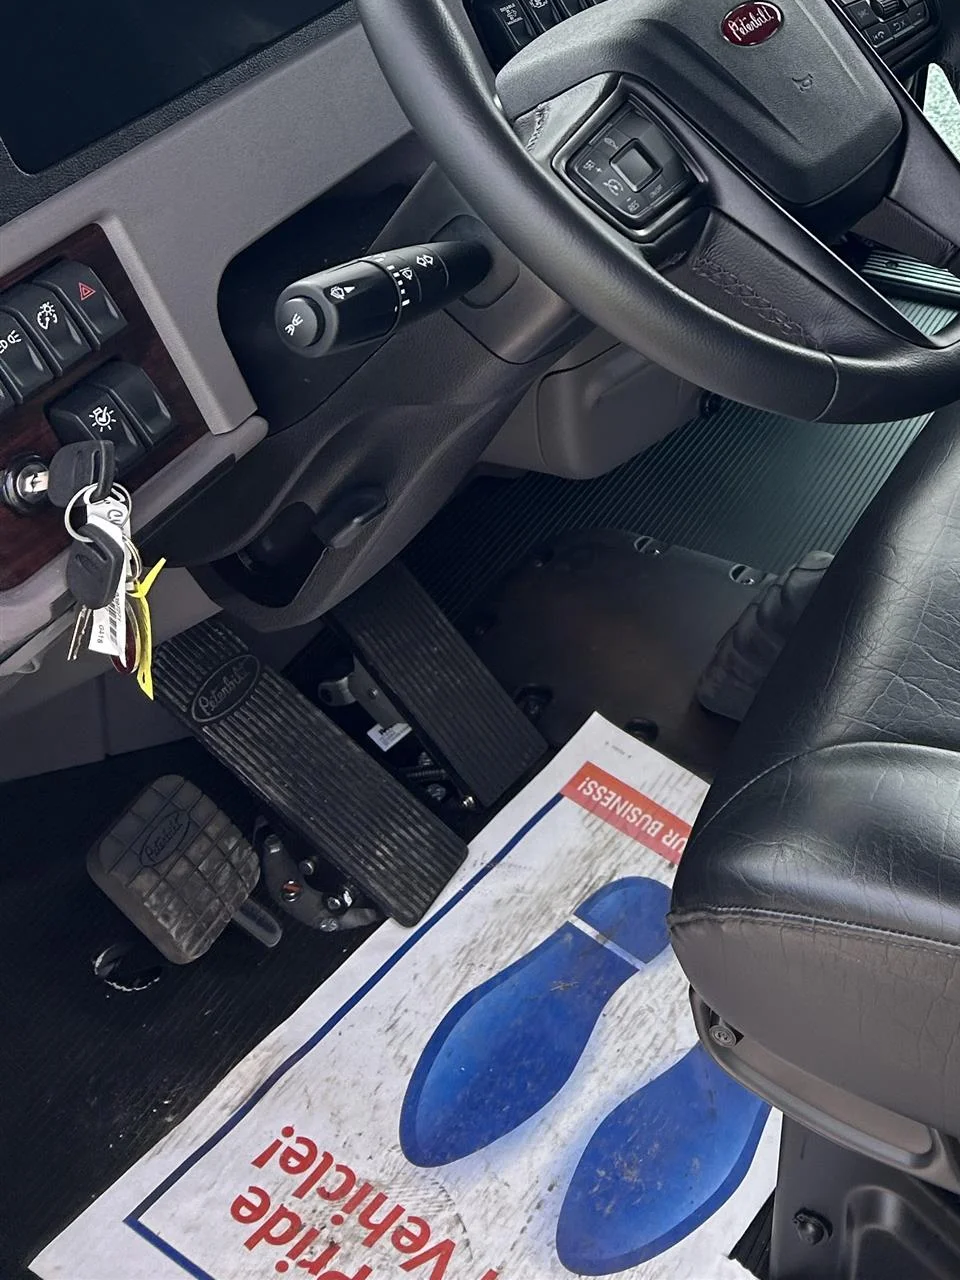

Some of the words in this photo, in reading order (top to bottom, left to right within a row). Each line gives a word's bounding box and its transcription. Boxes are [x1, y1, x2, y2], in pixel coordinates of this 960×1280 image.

[728, 5, 775, 41] Peterbilt
[576, 776, 665, 838] BUSINESS!
[251, 1125, 456, 1280] Vehicle!
